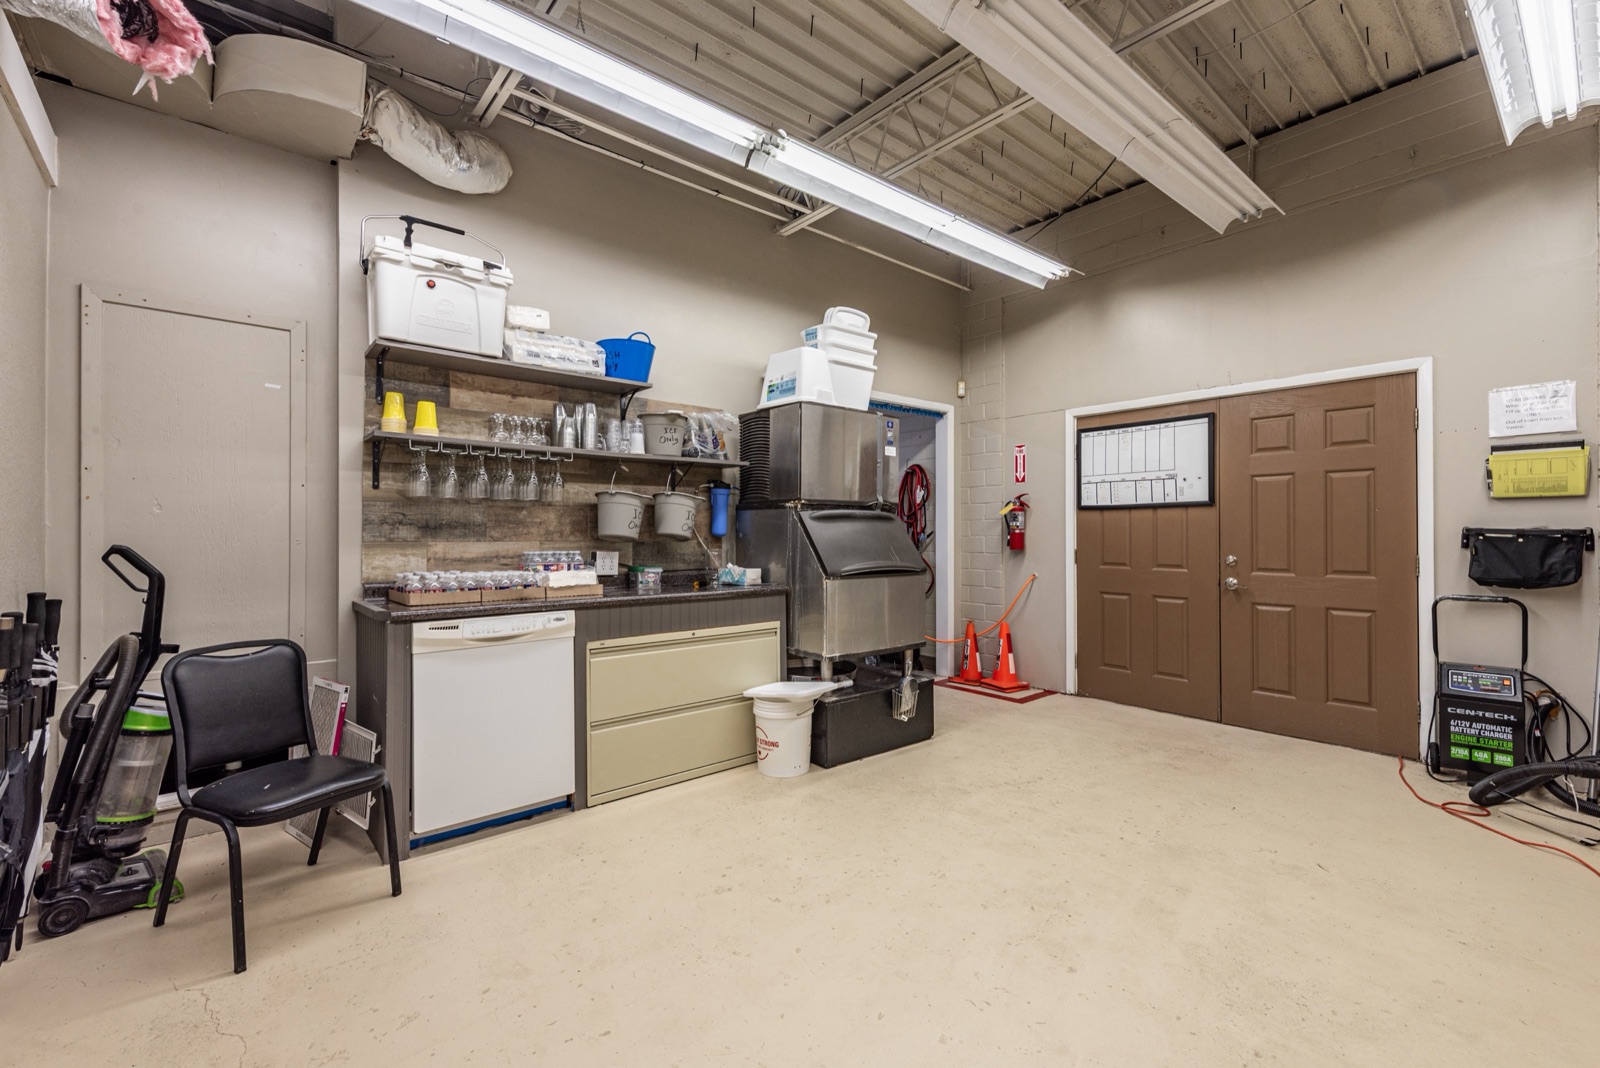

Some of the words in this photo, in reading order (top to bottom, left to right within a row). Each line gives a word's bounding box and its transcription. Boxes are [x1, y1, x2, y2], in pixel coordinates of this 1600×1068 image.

[1450, 719, 1470, 728] 6/12V
[1472, 722, 1513, 734] AUTOMATIC
[1450, 725, 1479, 736] BATTERY
[1480, 730, 1513, 740] CHARGER
[759, 738, 780, 748] STRONG
[1450, 733, 1478, 743] ENGINE
[1479, 738, 1514, 748] STARTER
[1474, 751, 1488, 759] 40A
